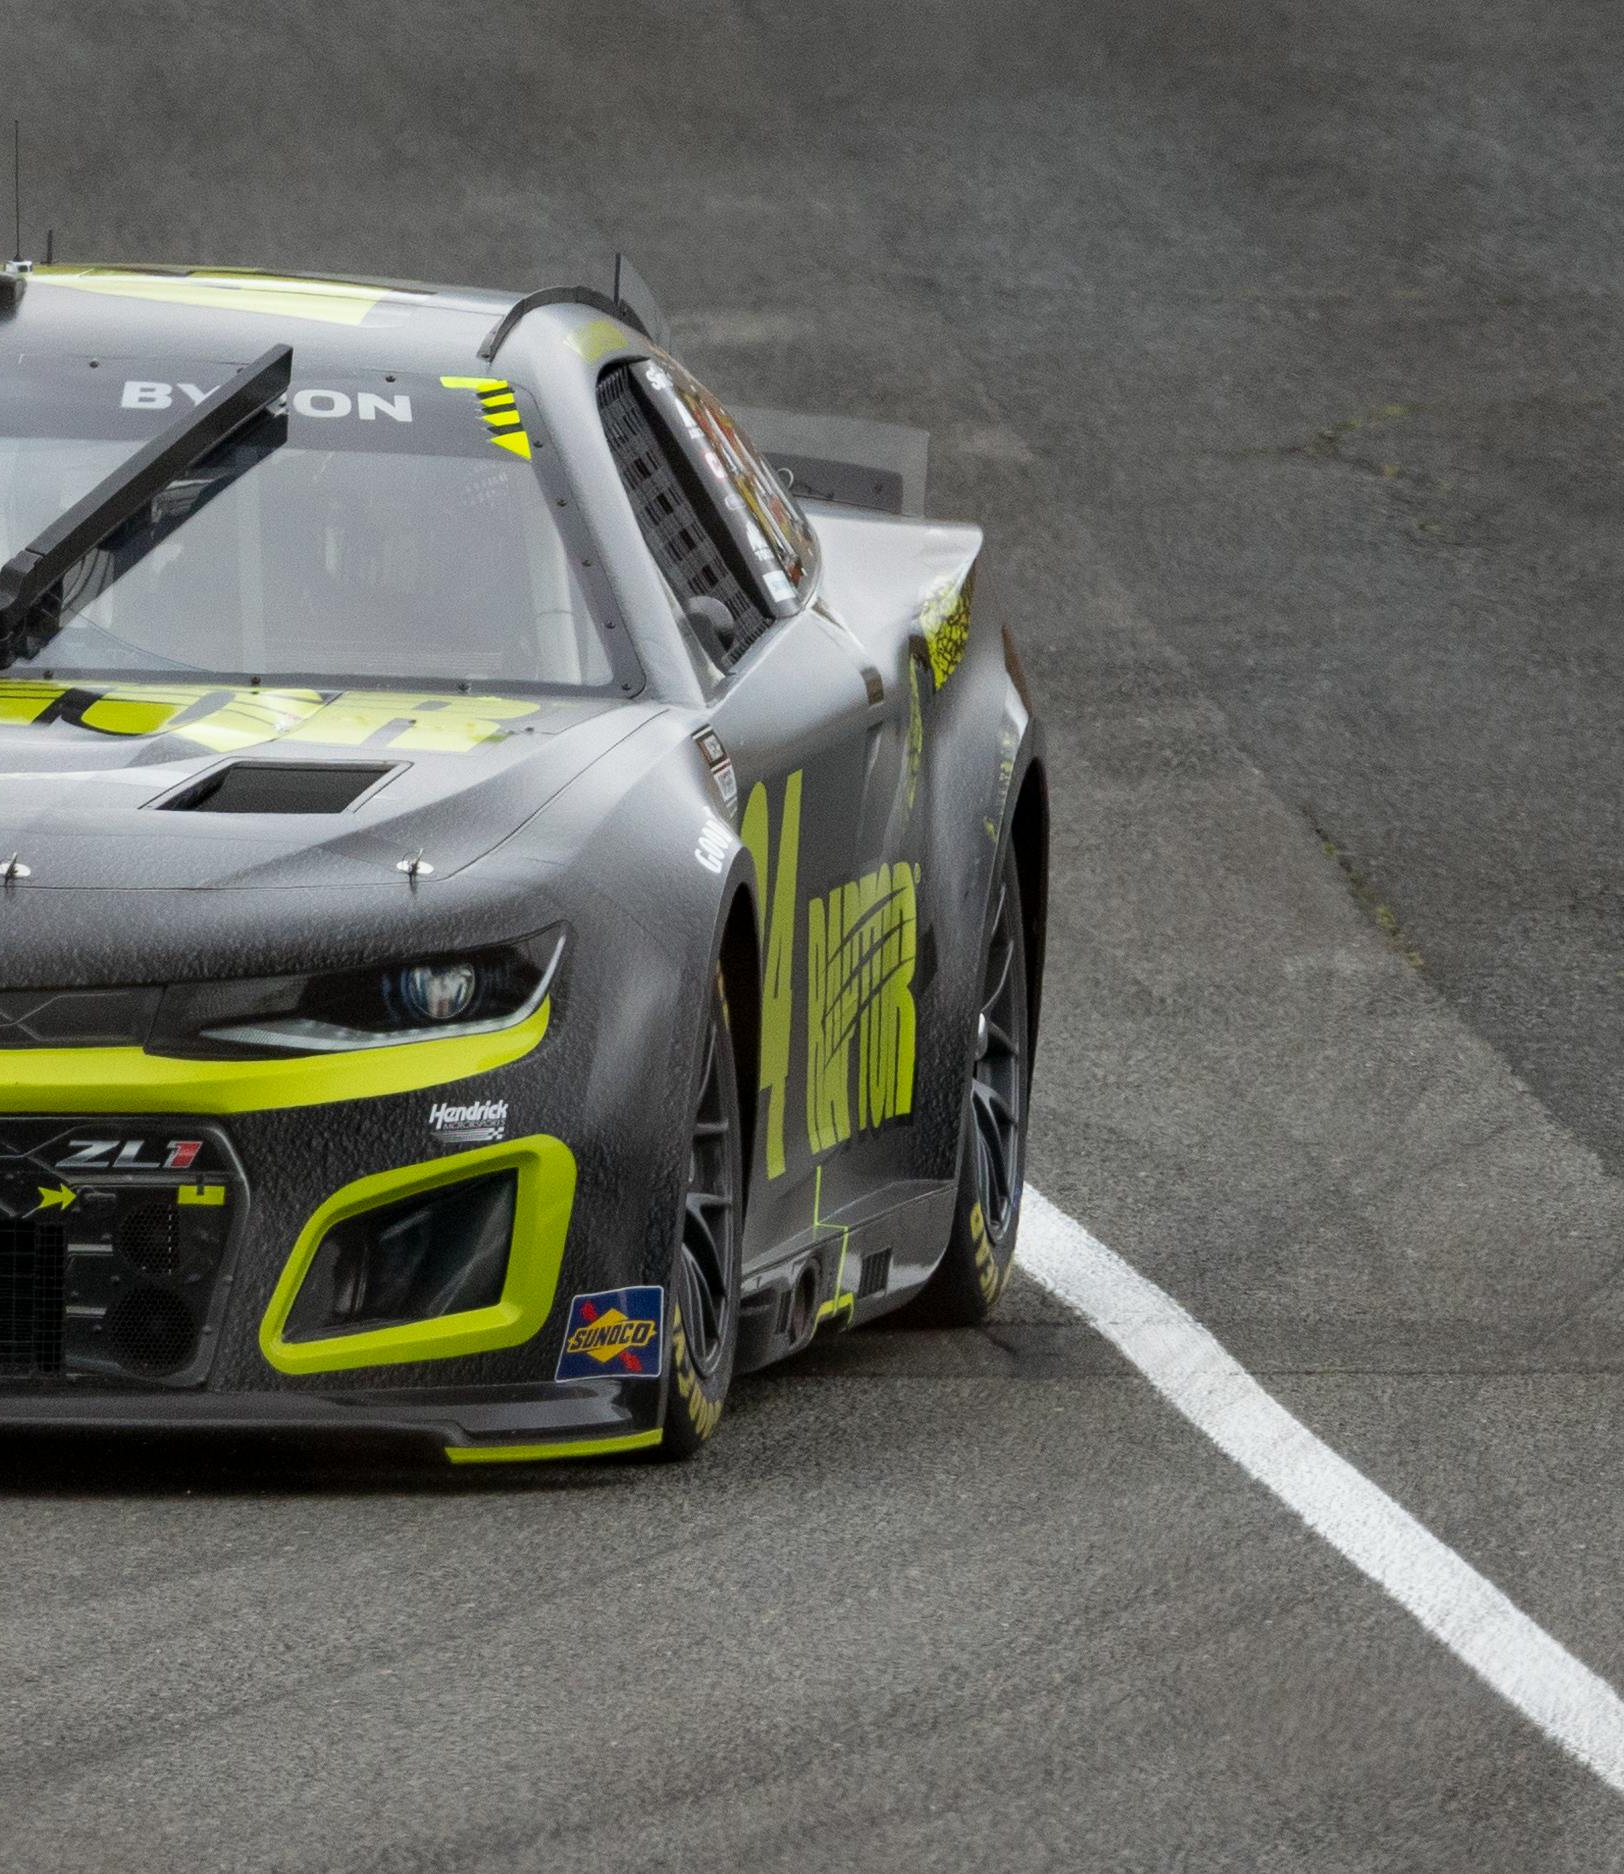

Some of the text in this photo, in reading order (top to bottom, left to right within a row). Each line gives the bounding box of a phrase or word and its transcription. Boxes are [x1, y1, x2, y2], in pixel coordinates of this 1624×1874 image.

[121, 380, 413, 422] BYON
[807, 862, 917, 1154] RAPTOR
[429, 1099, 509, 1130] Hendrick
[56, 1140, 203, 1168] ZL1
[570, 1322, 652, 1350] SUNOCO
